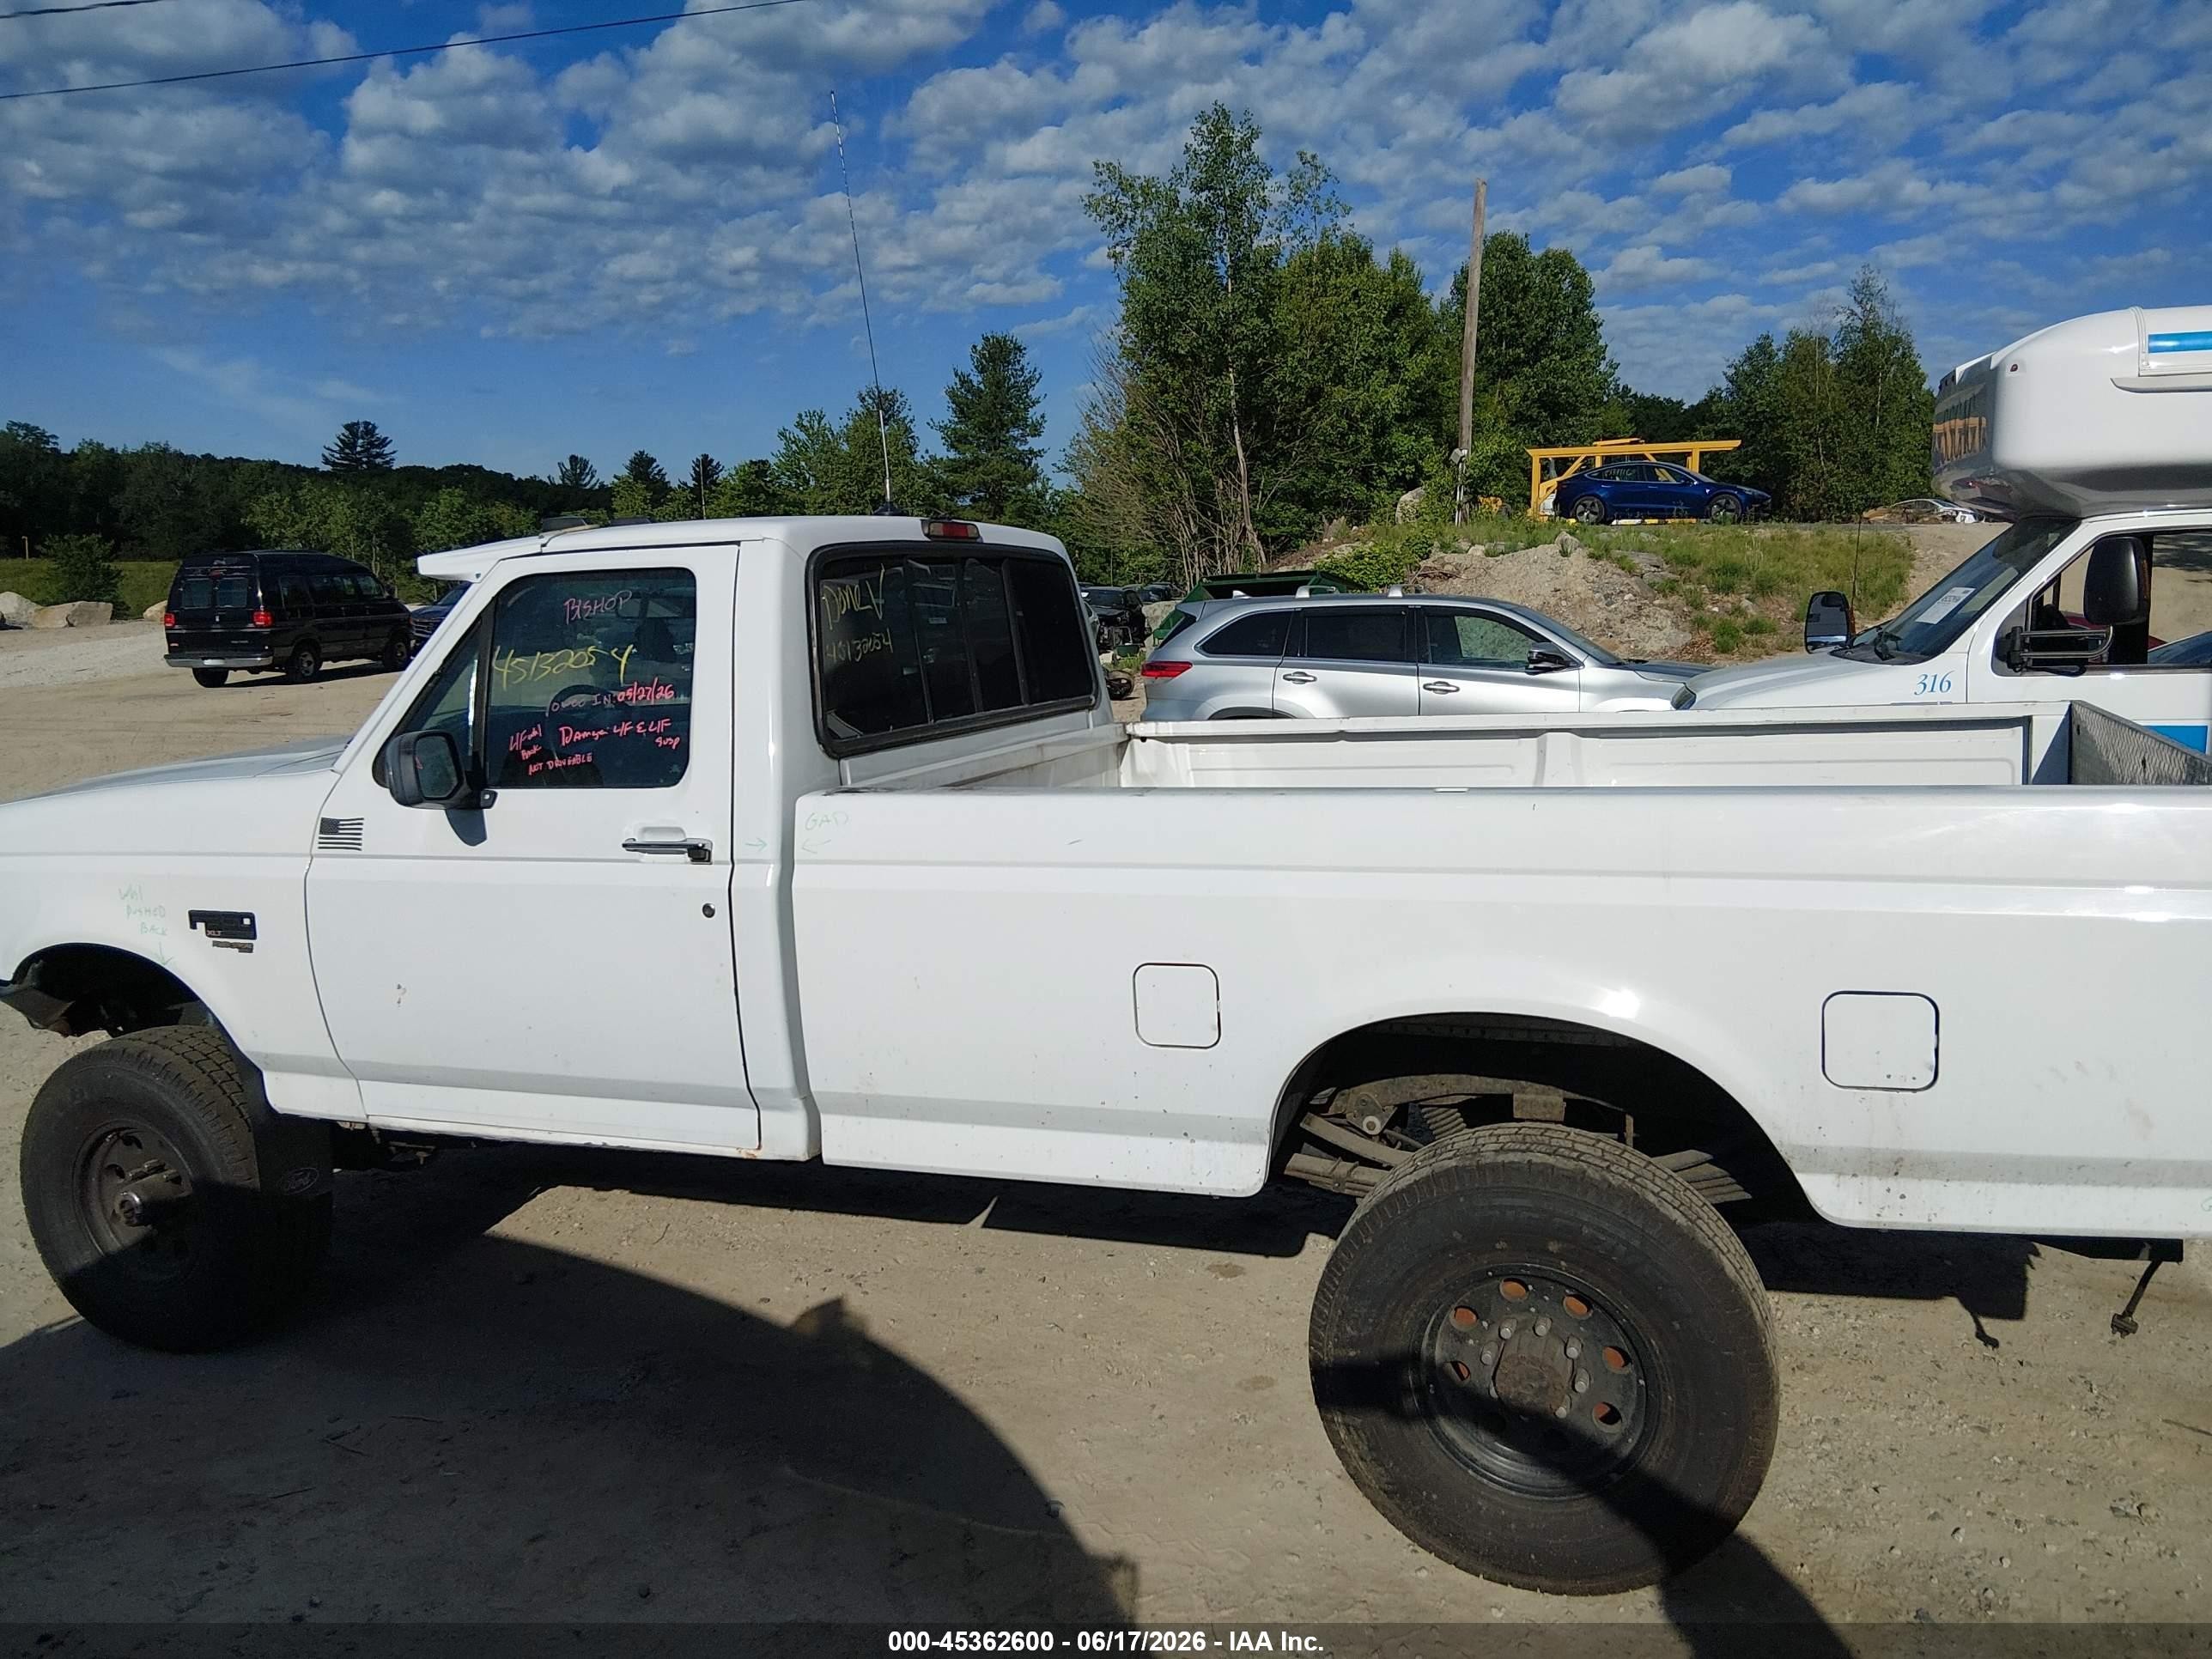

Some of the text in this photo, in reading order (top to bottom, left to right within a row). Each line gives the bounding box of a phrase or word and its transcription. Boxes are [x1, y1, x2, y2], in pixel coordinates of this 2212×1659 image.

[563, 590, 632, 625] BISHOP
[491, 643, 635, 691] 45132054
[617, 676, 675, 704] 05/27/26
[1914, 670, 1955, 696] 316
